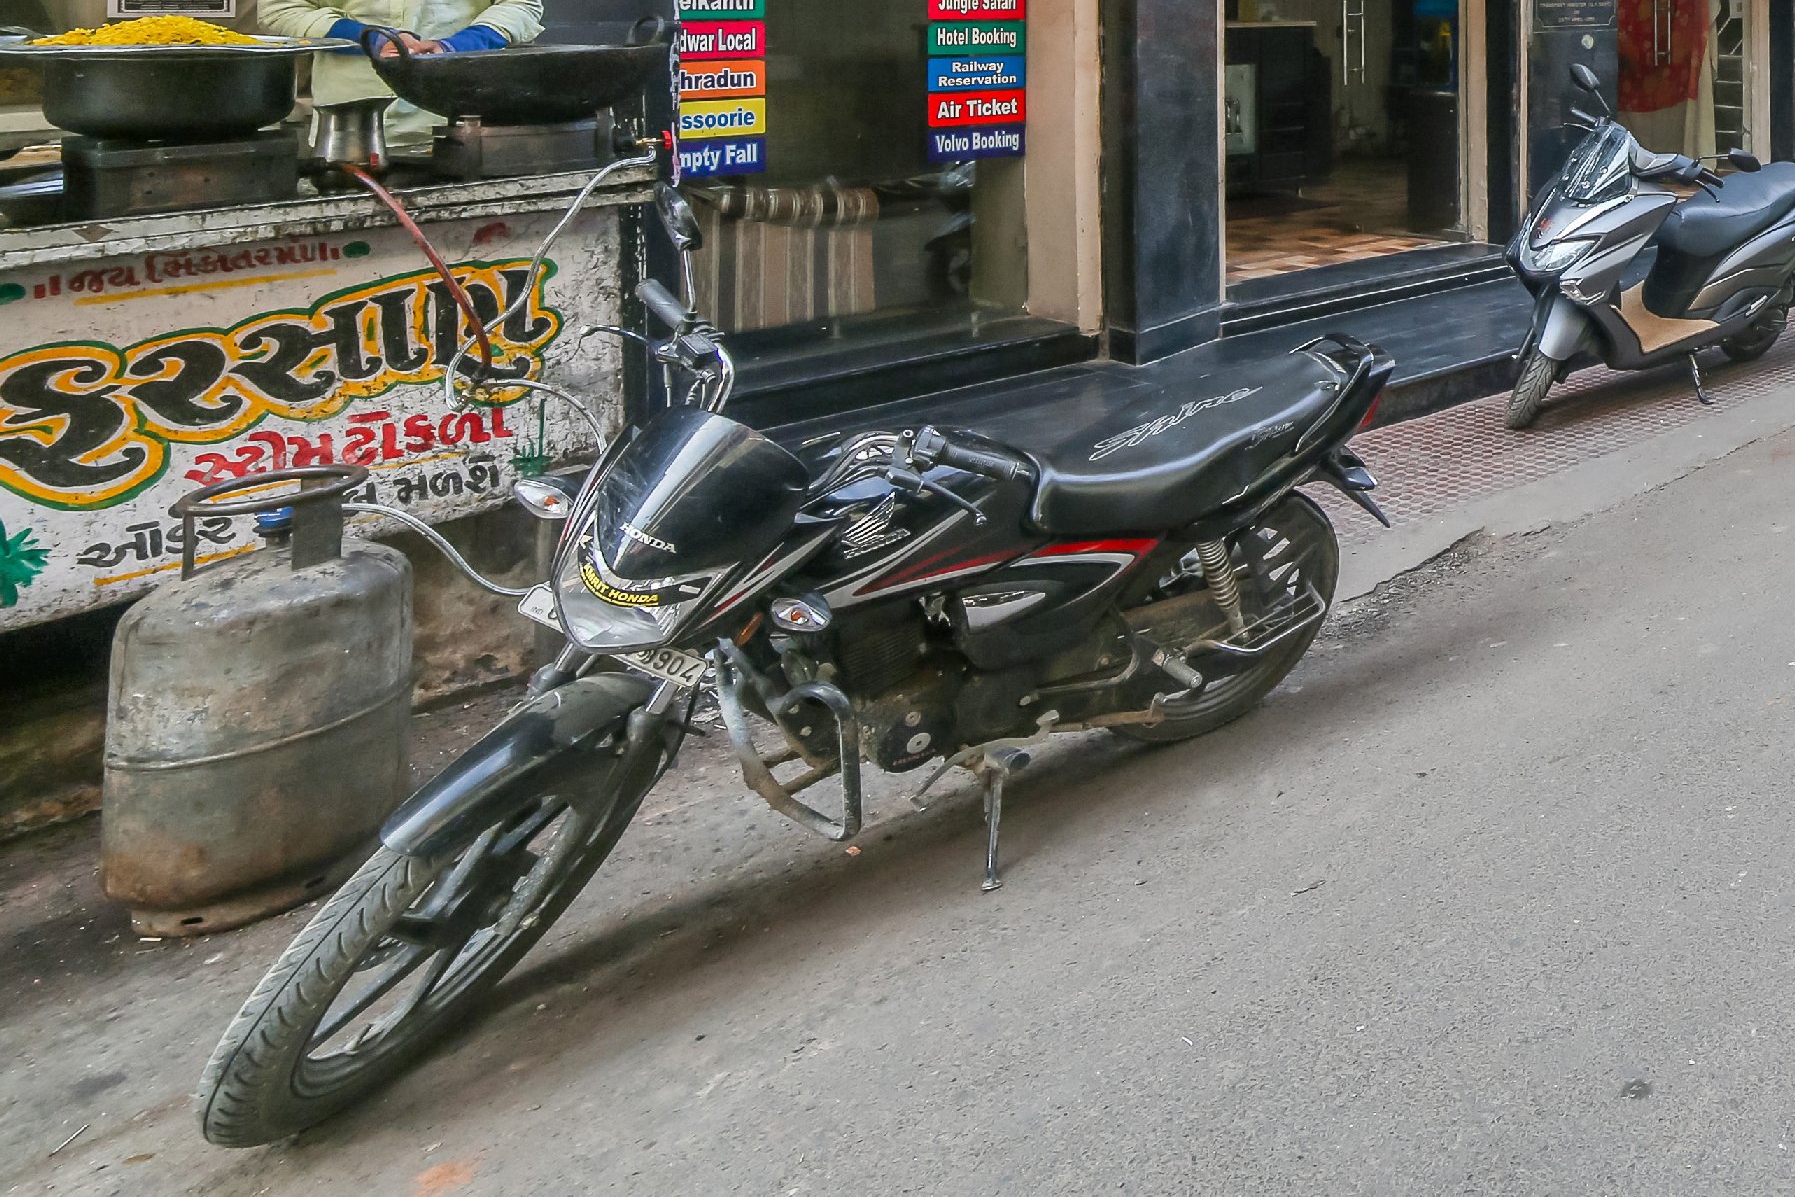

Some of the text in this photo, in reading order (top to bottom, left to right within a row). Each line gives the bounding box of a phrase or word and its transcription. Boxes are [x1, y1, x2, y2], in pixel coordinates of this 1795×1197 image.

[718, 28, 756, 50] Local
[937, 27, 1017, 49] Hotel Booking
[938, 73, 1017, 86] Reservation
[951, 61, 1004, 76] Railway
[680, 70, 755, 90] hradun
[682, 108, 755, 130] ssoorie
[937, 98, 1018, 119] Air Ticket
[936, 131, 1020, 154] Volvo Booking
[725, 144, 757, 165] Fall
[618, 521, 678, 554] HONDA
[582, 563, 660, 604] AMRIT HONDA
